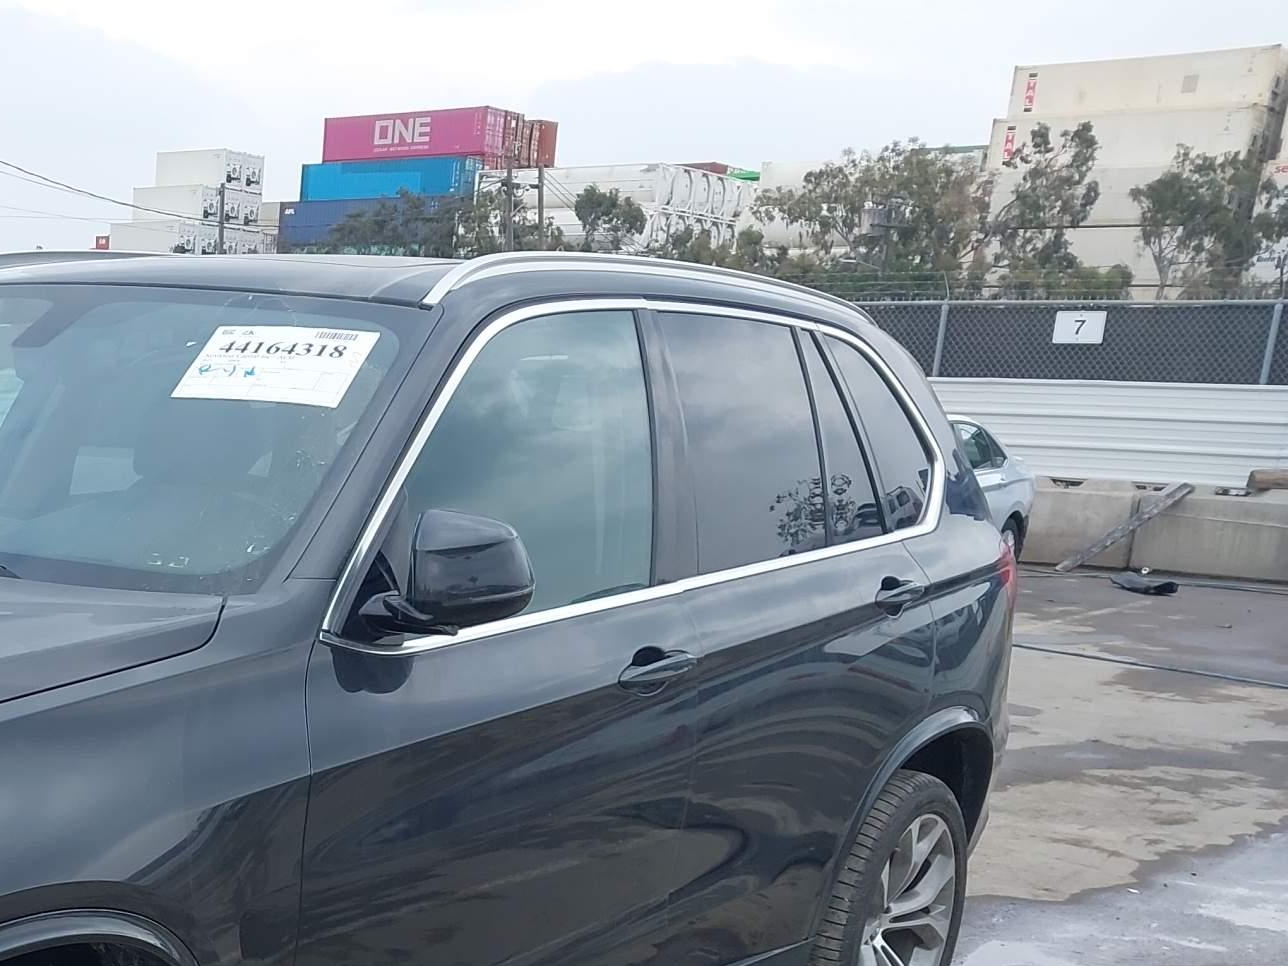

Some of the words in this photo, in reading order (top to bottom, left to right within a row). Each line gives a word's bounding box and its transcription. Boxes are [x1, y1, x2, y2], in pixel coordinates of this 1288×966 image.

[374, 117, 431, 145] ONE
[1074, 319, 1087, 335] 7
[219, 340, 348, 359] 44164318
